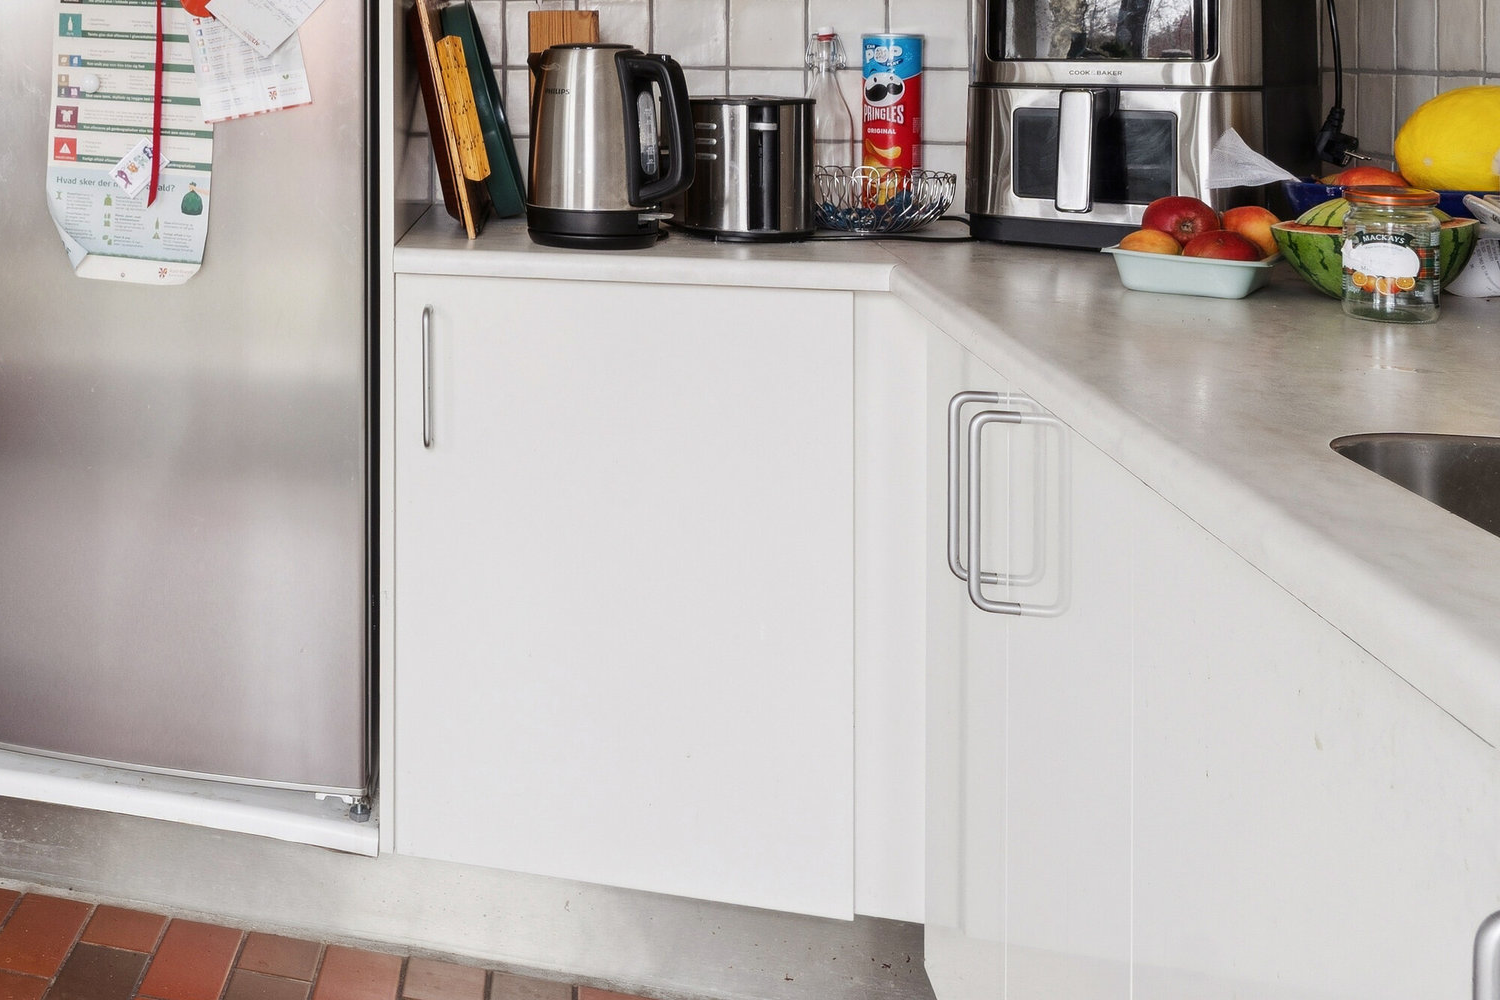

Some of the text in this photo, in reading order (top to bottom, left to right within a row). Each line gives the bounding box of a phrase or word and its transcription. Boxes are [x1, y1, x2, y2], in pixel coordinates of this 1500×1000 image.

[866, 45, 902, 64] POP
[864, 104, 904, 124] PRINGLES
[56, 176, 77, 185] Hvad
[80, 178, 95, 186] sker
[98, 179, 110, 187] der
[1362, 234, 1405, 244] MACKAYS
